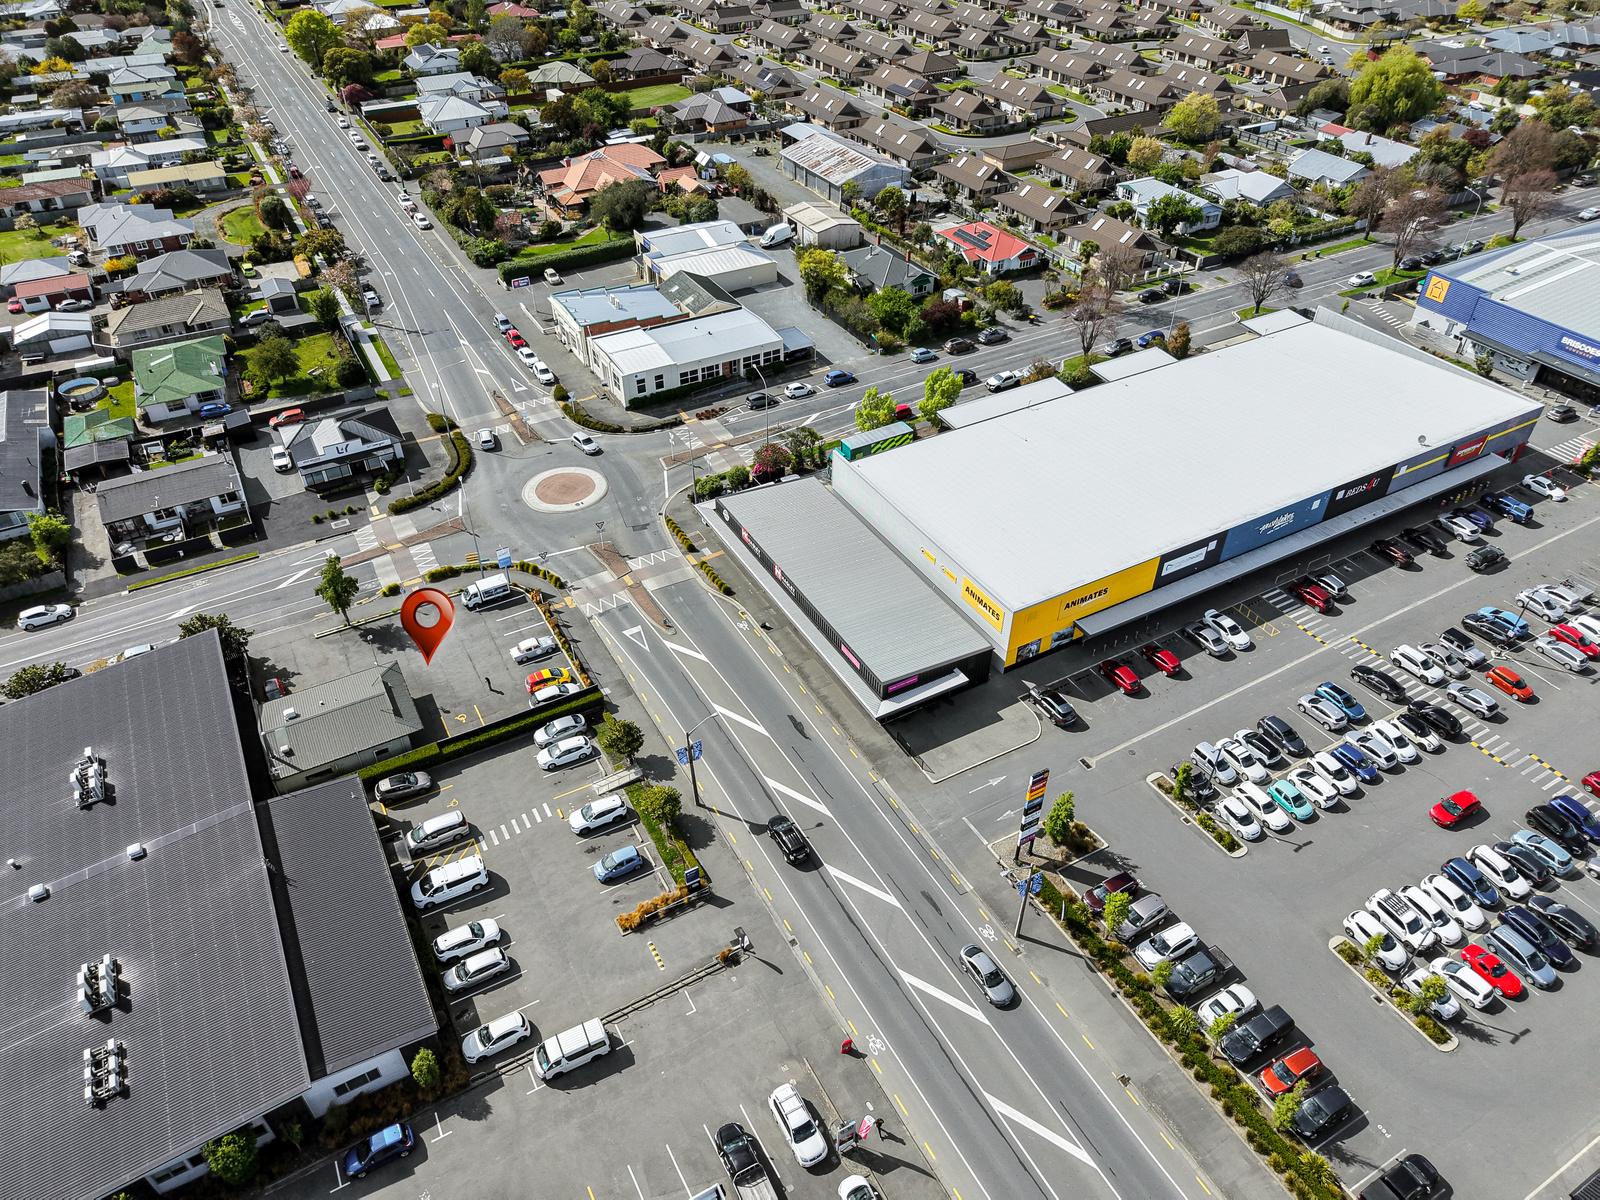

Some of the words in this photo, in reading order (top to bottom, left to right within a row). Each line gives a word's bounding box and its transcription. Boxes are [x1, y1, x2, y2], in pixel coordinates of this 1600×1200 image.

[1561, 336, 1600, 357] BRISCOES
[965, 586, 1001, 621] ANIMATES
[1063, 587, 1109, 611] ANIMATES
